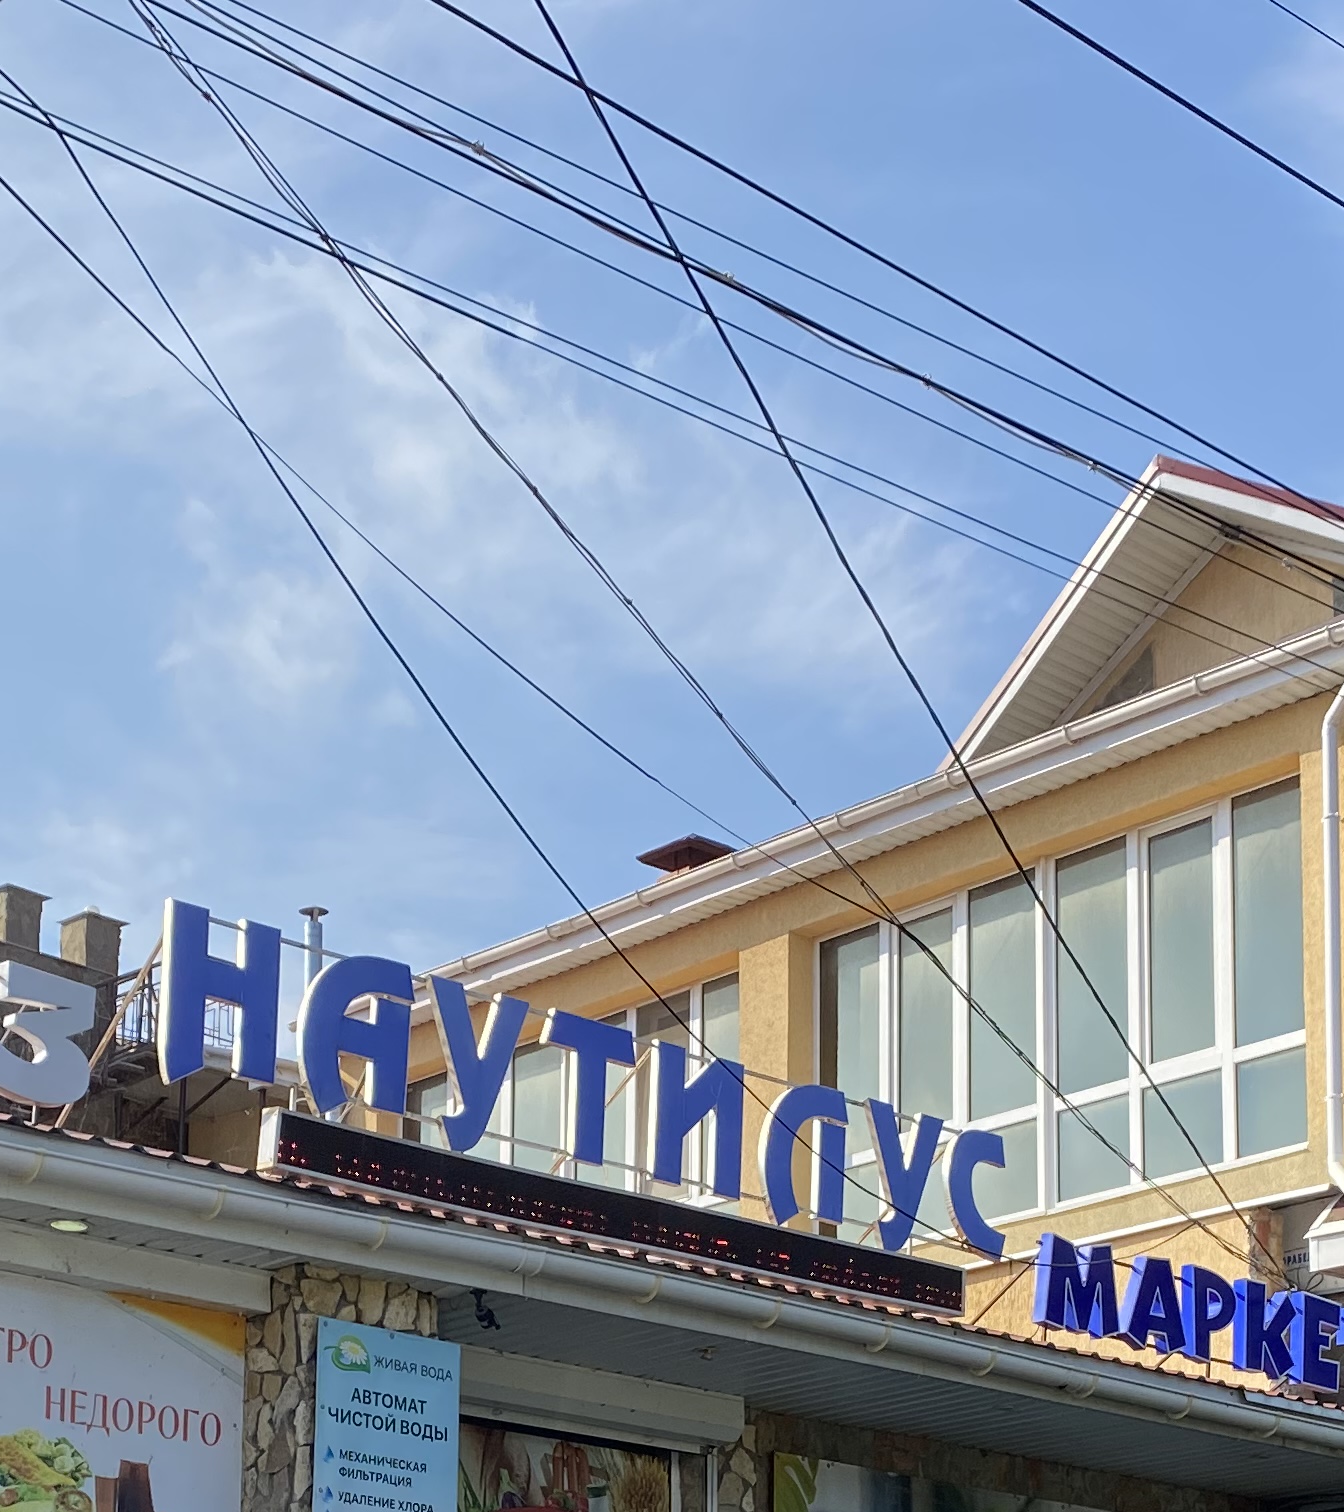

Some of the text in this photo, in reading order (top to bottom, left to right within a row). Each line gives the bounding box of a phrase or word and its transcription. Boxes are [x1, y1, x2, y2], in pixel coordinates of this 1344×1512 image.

[157, 897, 1007, 1262] НАУТИЛУС
[373, 1354, 454, 1383] ЖИВАЯ ВОДА
[350, 1386, 428, 1415] АВТОМАТ
[44, 1385, 223, 1447] НЕДОРОГО
[327, 1405, 448, 1442] ЧИСТОЙ ВОДЫ
[338, 1448, 428, 1474] МЕХАНИЧЕСКАЯ
[338, 1466, 413, 1488] ФИЛЬТРАЦИЯ
[338, 1490, 396, 1510] УДАЛЕНИЕ
